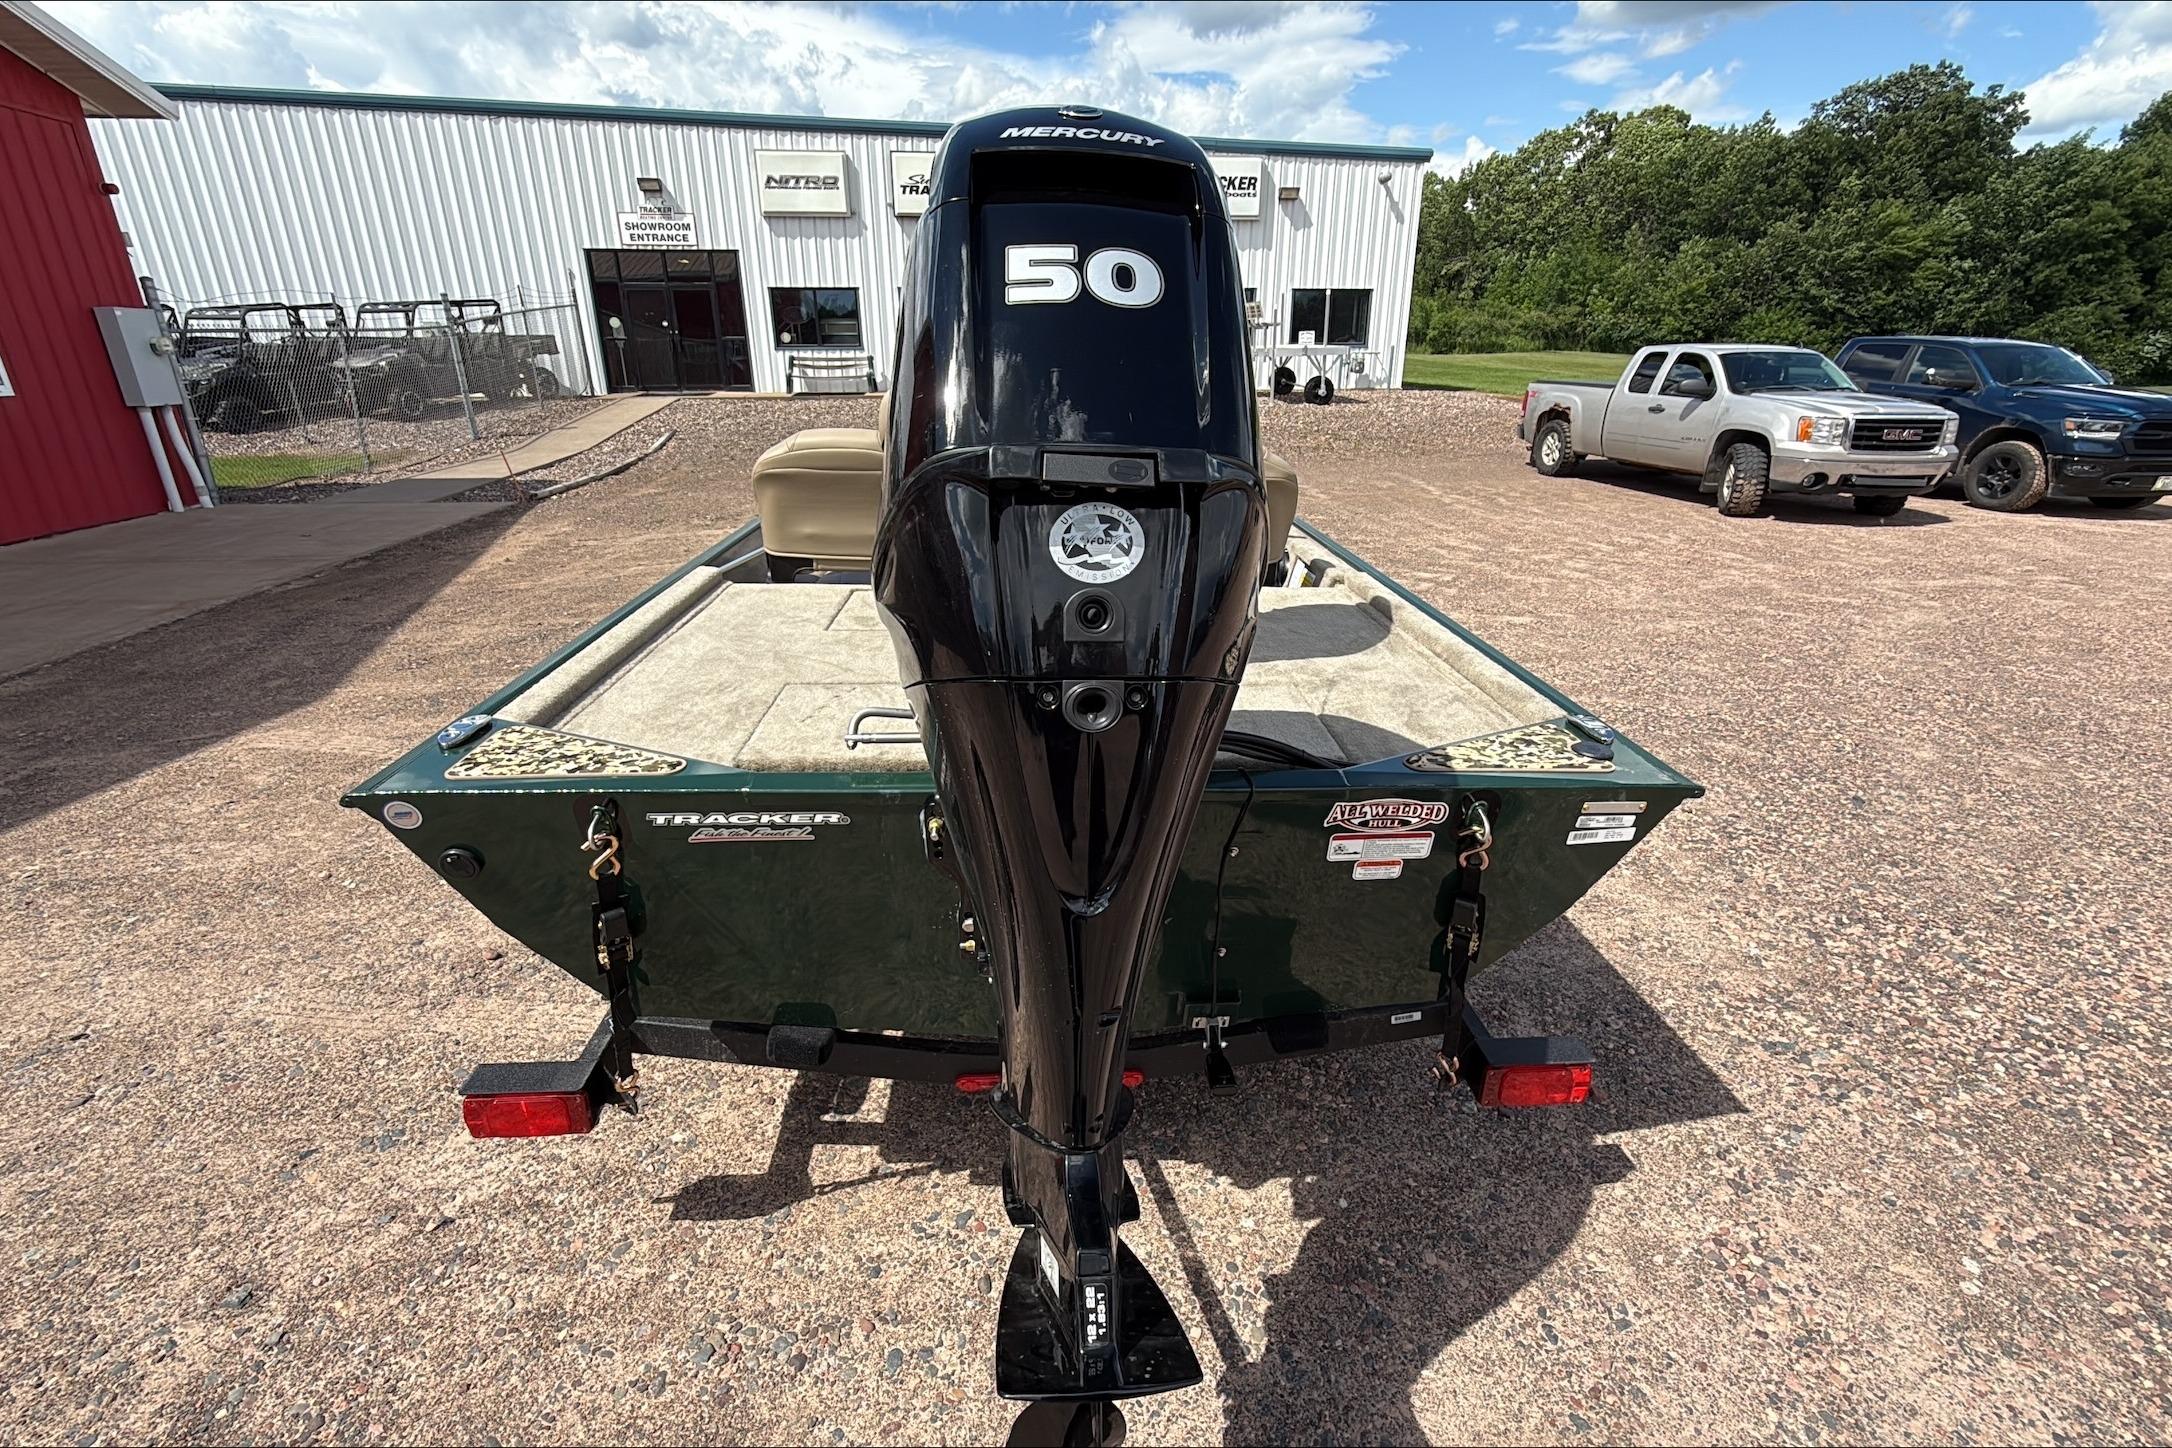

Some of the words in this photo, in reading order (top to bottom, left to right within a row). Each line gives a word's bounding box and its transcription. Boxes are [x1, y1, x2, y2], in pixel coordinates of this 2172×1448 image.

[999, 126, 1165, 147] MERCURY
[764, 175, 840, 186] NITRO
[1220, 176, 1258, 190] CKER
[624, 222, 691, 231] SHOWROOM
[629, 233, 690, 242] ENTRANCE
[1005, 244, 1165, 308] 50
[1882, 428, 1923, 441] GMC
[1060, 504, 1099, 525] ULTRA
[1109, 507, 1135, 525] LOW
[1067, 563, 1130, 581] EMISSION
[648, 813, 841, 825] TRACKER
[1328, 804, 1366, 822] ALL
[1370, 803, 1446, 821] WELDED
[1368, 819, 1402, 828] HULL
[694, 828, 724, 837] Fish
[727, 828, 749, 837] the
